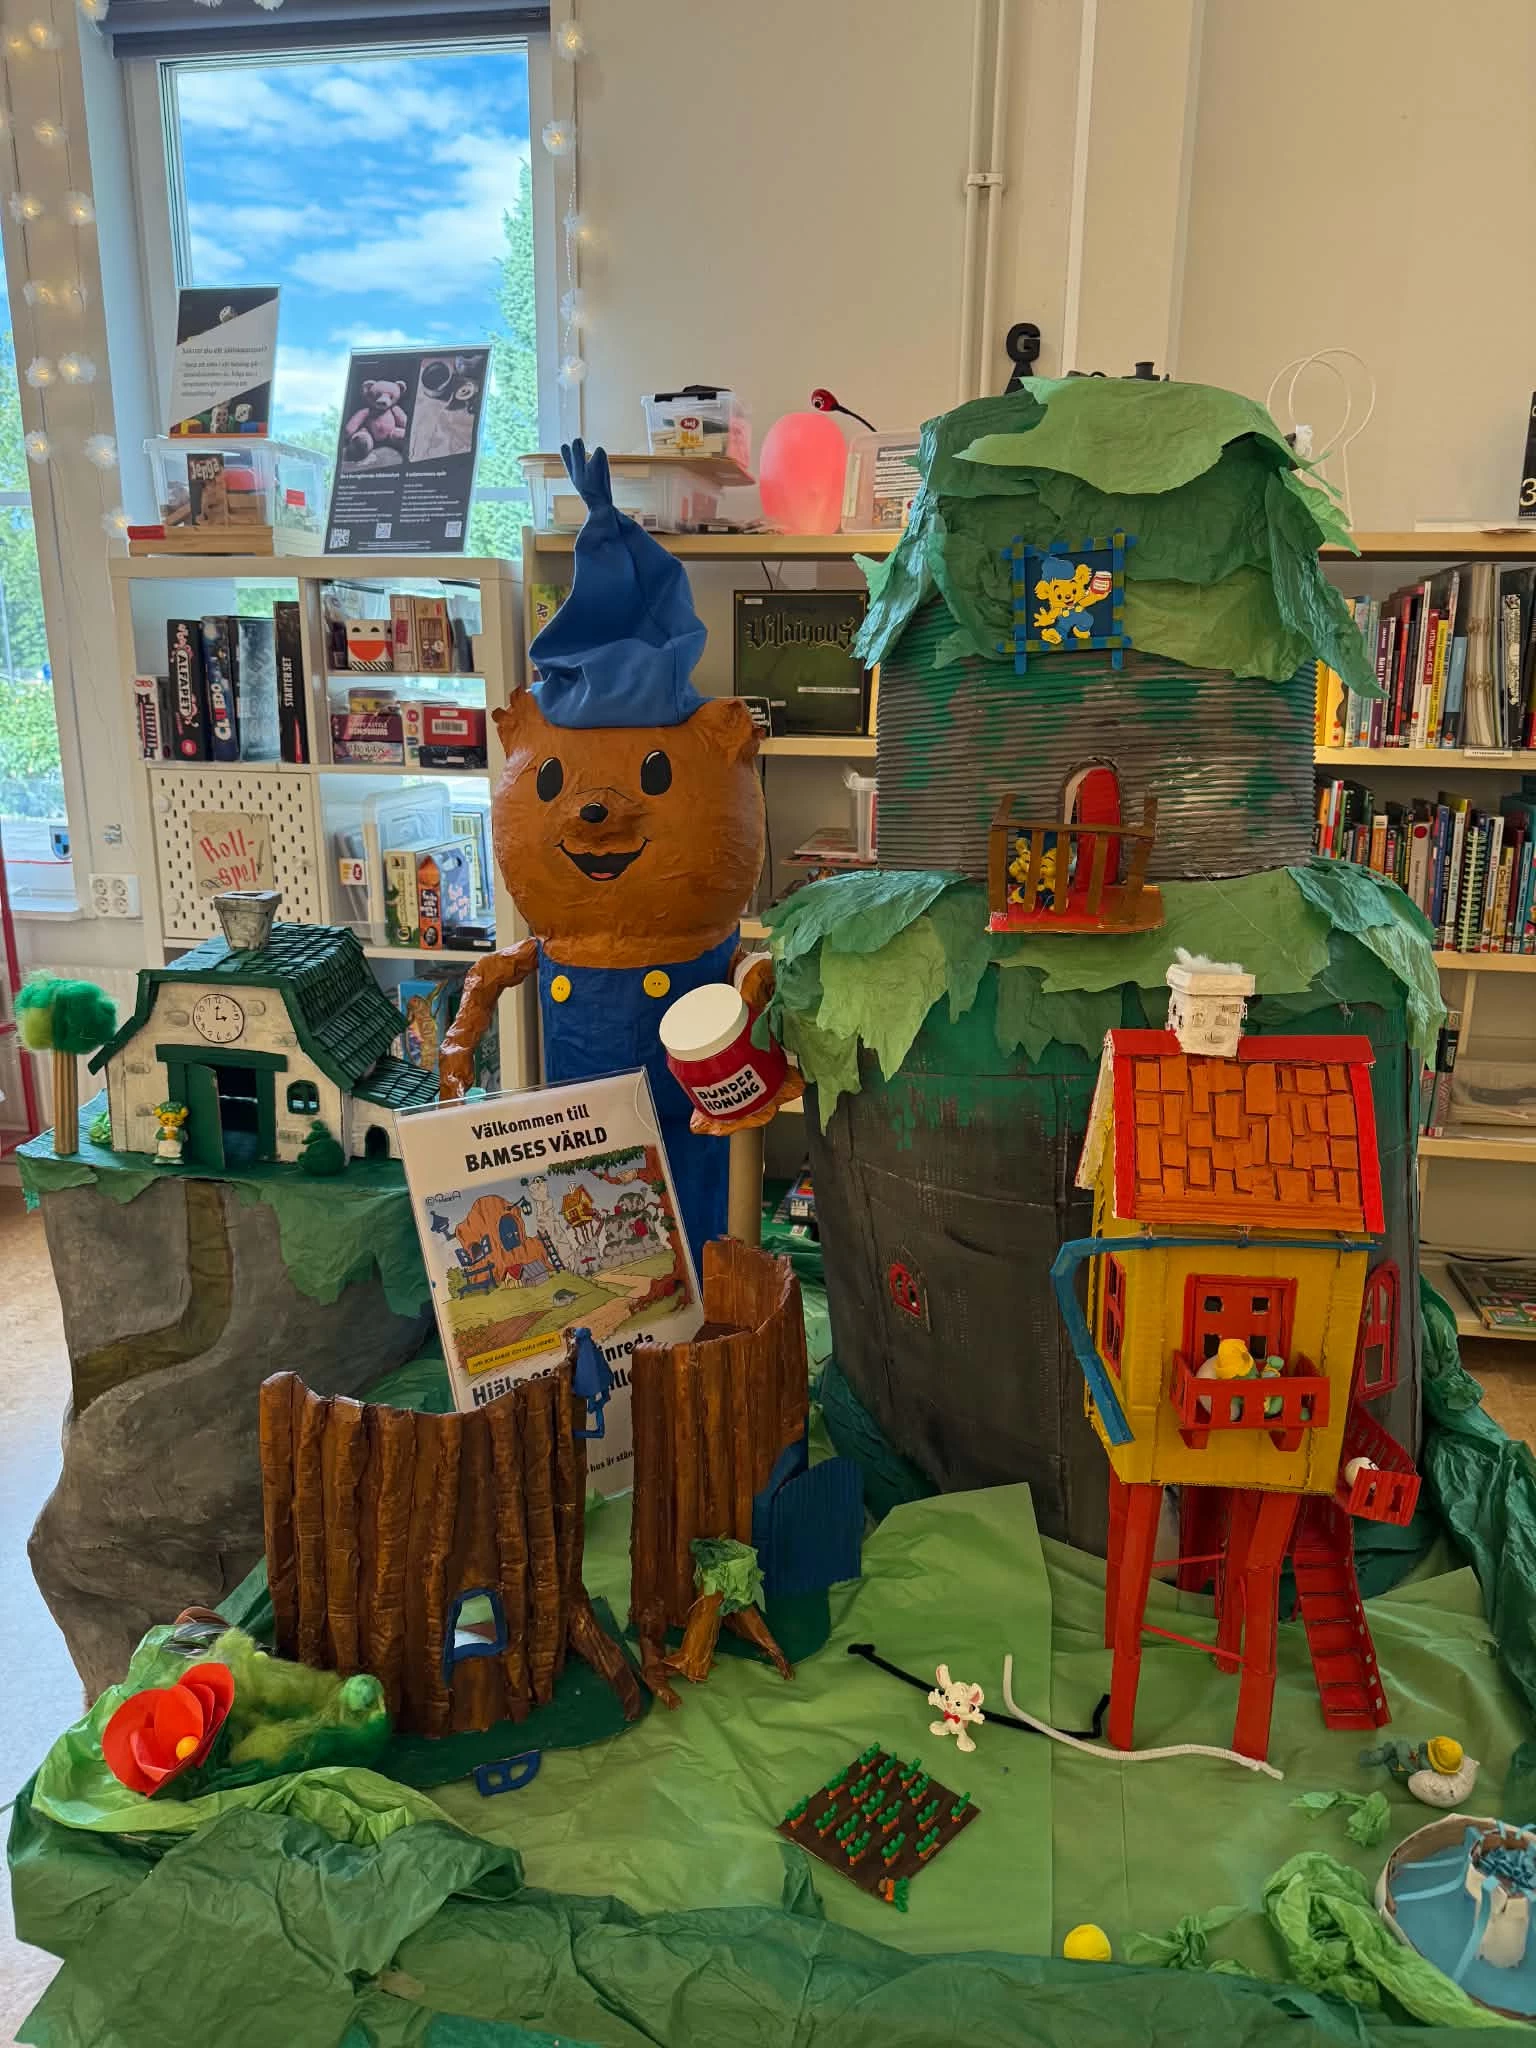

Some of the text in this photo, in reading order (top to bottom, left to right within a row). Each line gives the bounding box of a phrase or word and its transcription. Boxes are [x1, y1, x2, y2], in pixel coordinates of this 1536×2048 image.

[191, 457, 220, 480] Jenga
[177, 655, 190, 714] ALFAPET
[282, 656, 294, 707] STARTER SET
[211, 684, 231, 740] CLUEDO
[200, 829, 255, 863] Roll-
[697, 1070, 753, 1099] DUNDER
[704, 1082, 760, 1110] HONUNG
[471, 1103, 590, 1141] Välkommen till
[465, 1126, 608, 1173] BAMSES VÄRLD
